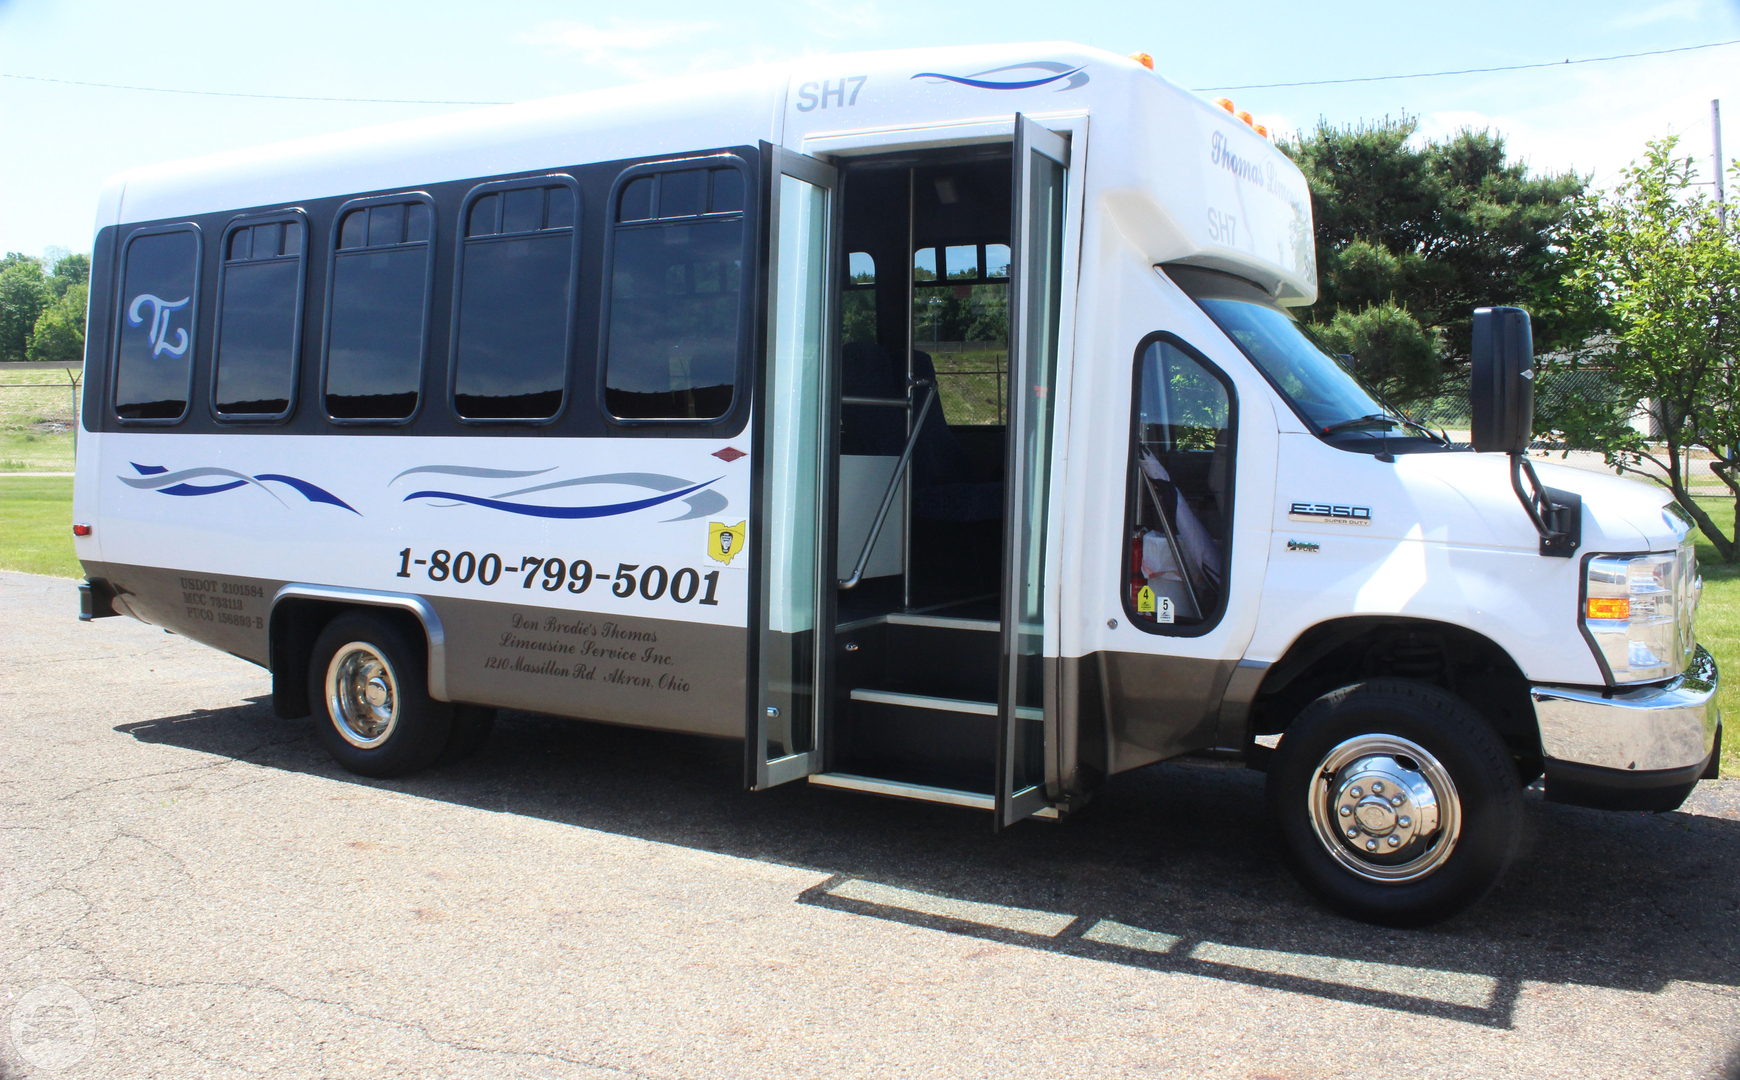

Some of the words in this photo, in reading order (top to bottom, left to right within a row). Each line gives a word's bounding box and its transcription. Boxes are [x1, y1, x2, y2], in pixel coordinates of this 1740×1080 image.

[796, 75, 868, 113] SH7
[1211, 130, 1264, 187] Thomas
[1207, 206, 1236, 246] SH7
[180, 577, 218, 592] USDOT
[222, 582, 264, 598] 2101584
[396, 547, 720, 606] 1-800-799-5001
[182, 592, 207, 606] MCC
[210, 596, 243, 611] 733113
[1143, 589, 1149, 600] 4
[1163, 599, 1169, 611] 5
[186, 606, 214, 621] PUCO
[217, 612, 264, 630] 156893-B
[512, 613, 539, 631] Don
[543, 616, 597, 637] Brodie's
[601, 621, 657, 643] Thomas
[499, 632, 576, 654] Limousine
[581, 640, 637, 661] Service
[641, 647, 674, 666] Inc.
[484, 656, 510, 670] 1210
[510, 655, 570, 677] Massillon
[572, 663, 597, 681] Rd.
[603, 668, 654, 689] Akron,
[658, 672, 691, 692] Ohio
